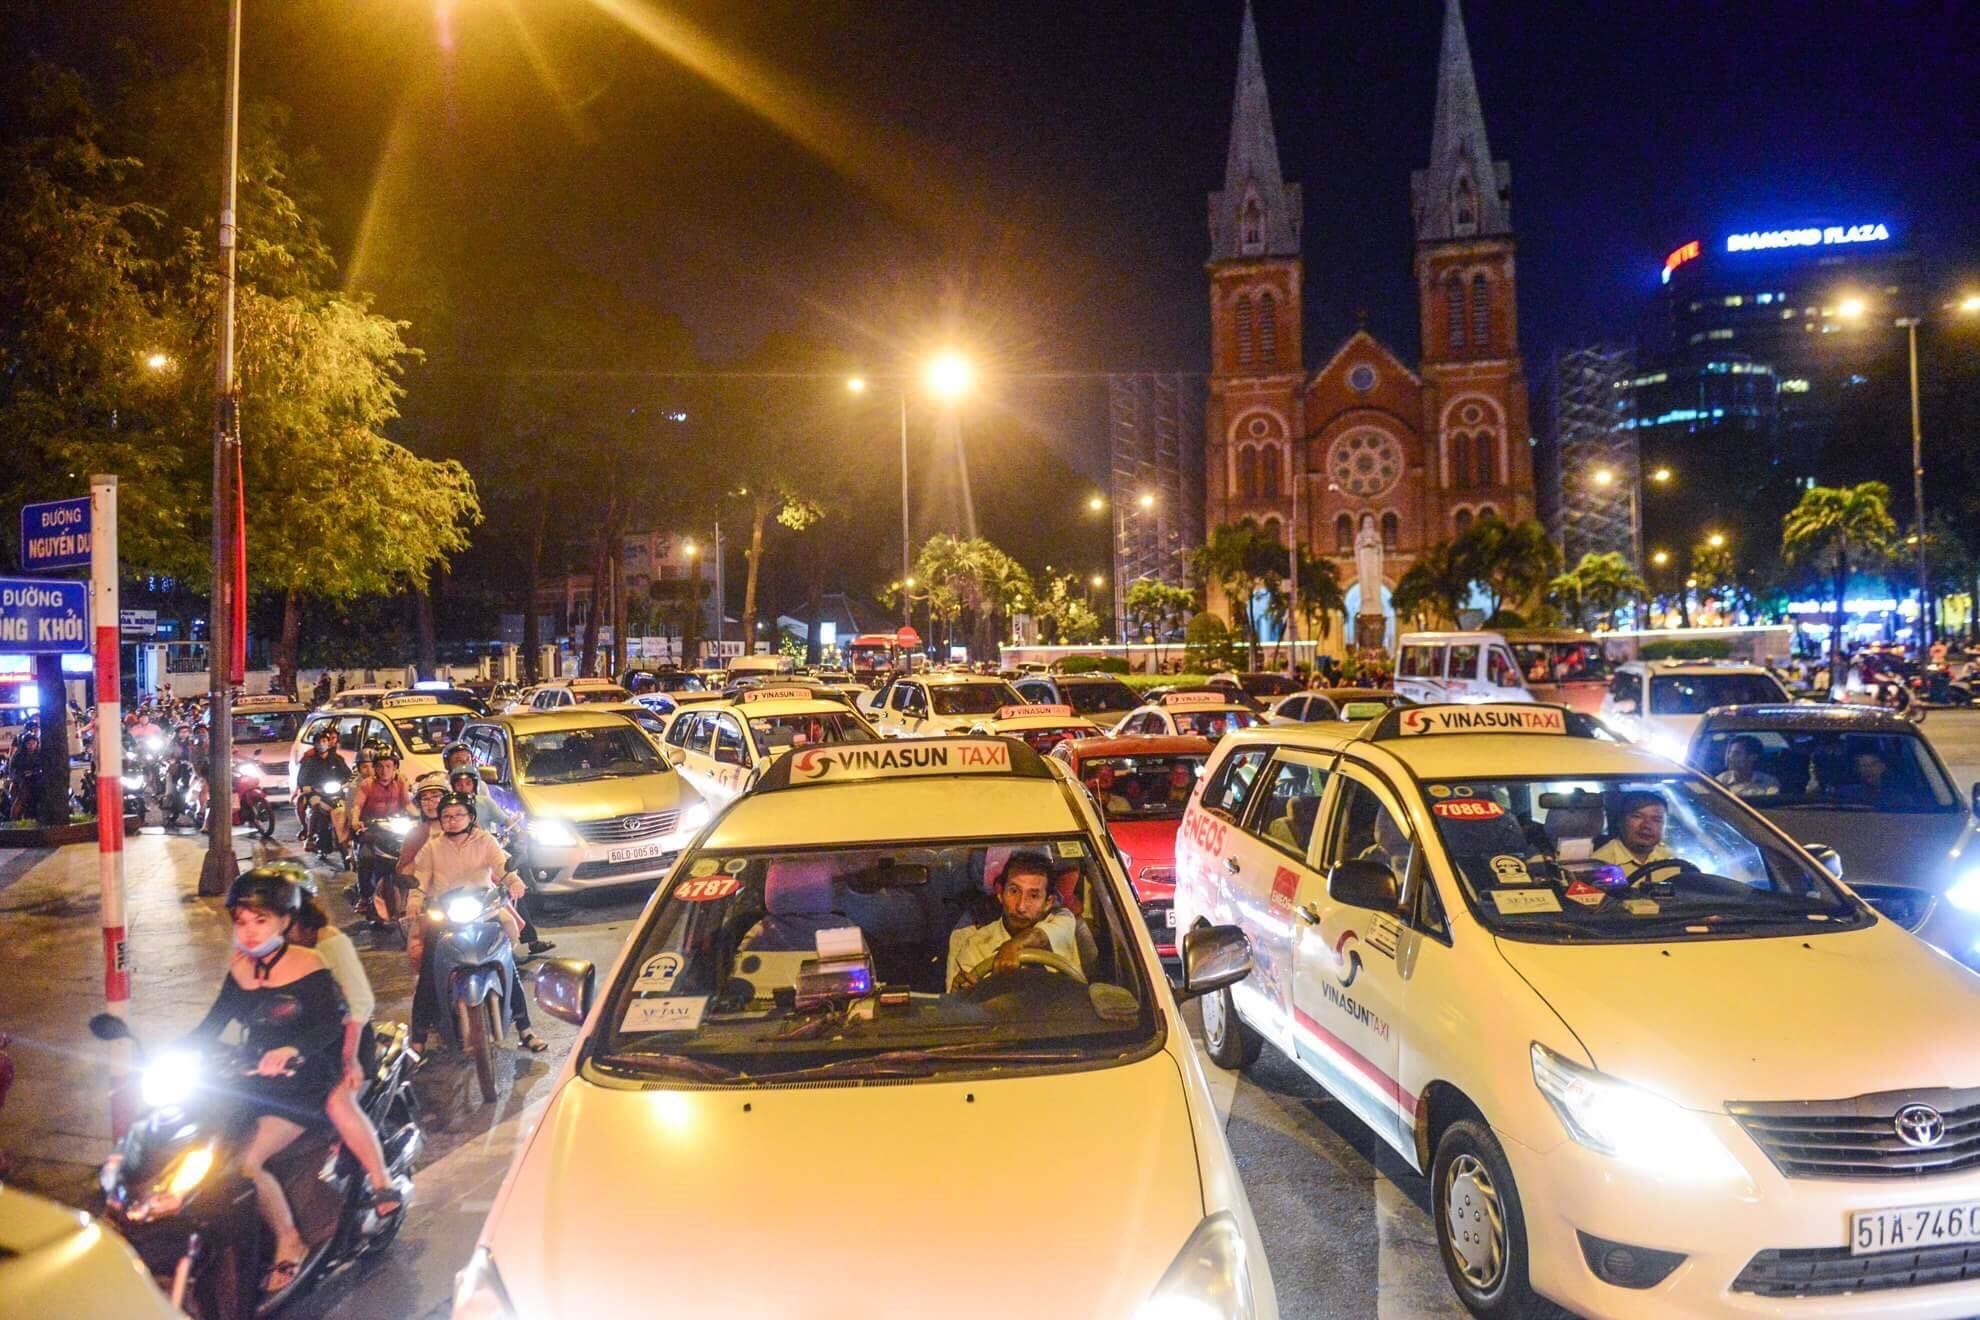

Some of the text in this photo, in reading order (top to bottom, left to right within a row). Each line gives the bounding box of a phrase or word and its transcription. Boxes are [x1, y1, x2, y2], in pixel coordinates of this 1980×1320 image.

[1823, 223, 1889, 244] PLAZA
[3, 586, 63, 607] ĐƯỜNG
[38, 608, 83, 641] KHỞI
[838, 746, 1005, 770] VINASUN TAXI
[1184, 808, 1227, 856] ENEOS
[679, 879, 737, 897] 4787
